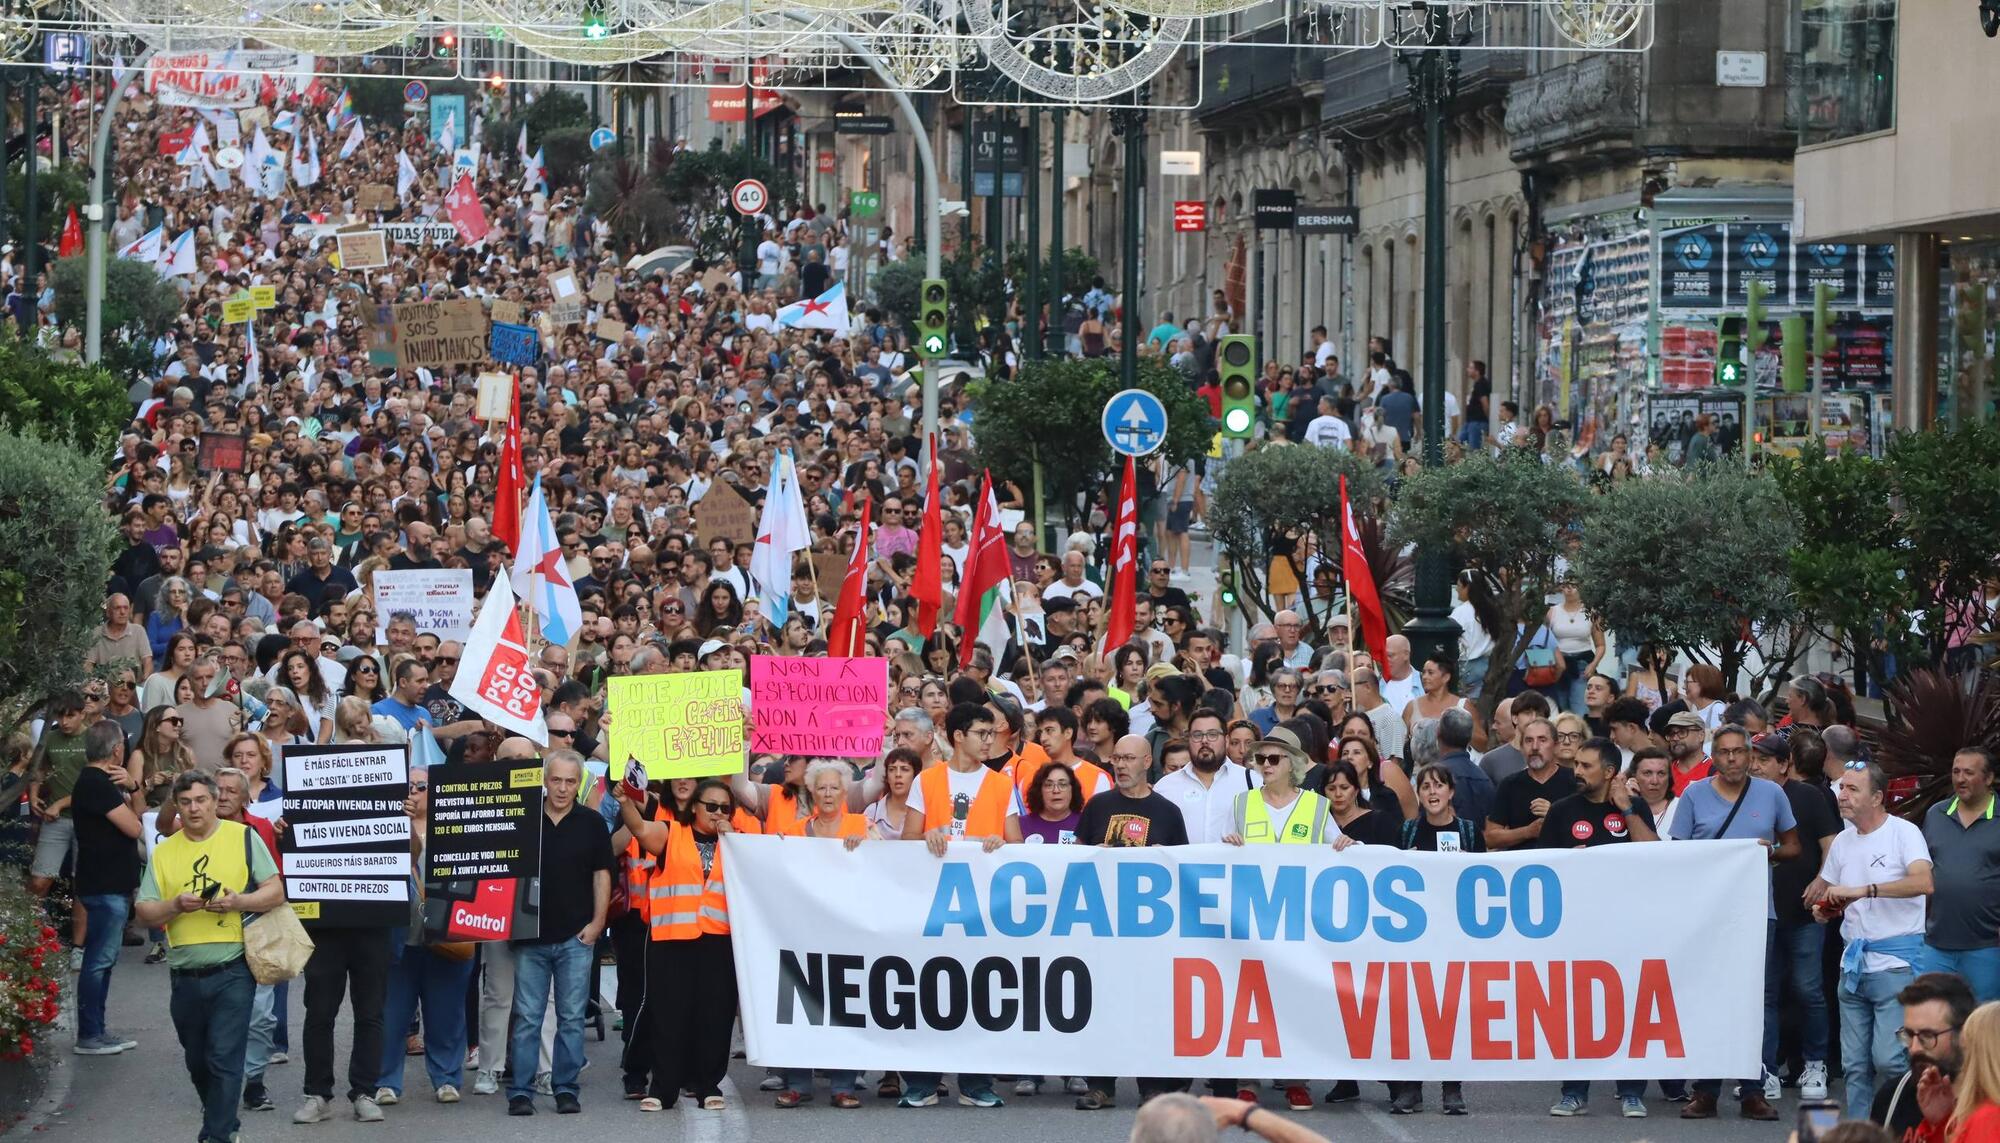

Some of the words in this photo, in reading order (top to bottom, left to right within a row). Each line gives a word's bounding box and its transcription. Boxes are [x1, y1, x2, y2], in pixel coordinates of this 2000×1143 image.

[740, 190, 760, 203] 40
[1298, 216, 1354, 225] BERSHKA
[406, 321, 439, 337] SOIS
[770, 661, 820, 677] NON
[485, 663, 517, 704] PSG
[754, 681, 878, 702] ESPECULACION
[758, 708, 797, 727] NON
[808, 705, 819, 728] Á
[754, 733, 883, 753] XENTRIFICACION
[304, 759, 310, 771] É
[312, 756, 331, 770] MÁIS
[332, 756, 354, 768] FÁCIL
[355, 756, 387, 767] ENTRAR
[303, 778, 313, 788] NA
[352, 774, 363, 784] DE
[364, 772, 393, 783] BENITO
[436, 785, 441, 793] O
[442, 784, 469, 793] CONTROL
[470, 783, 479, 791] DE
[480, 782, 503, 790] PREZOS
[283, 799, 300, 810] QUE
[302, 799, 335, 810] ATOPAR
[336, 800, 373, 811] VIVENDA
[374, 800, 387, 811] EN
[388, 801, 404, 811] VIG
[436, 798, 465, 807] PREVISTO
[466, 797, 474, 806] NA
[476, 796, 485, 805] LEI
[486, 796, 495, 804] DE
[496, 794, 522, 804] VIVENDA
[435, 810, 461, 821] SUPORÍA
[462, 811, 471, 819] UN
[472, 810, 495, 819] AFORRO
[496, 809, 504, 817] DE
[506, 808, 526, 816] ENTRE
[303, 825, 327, 840] MÁIS
[329, 825, 371, 839] VIVENDA
[373, 822, 408, 835] SOCIAL
[435, 826, 445, 835] 120
[446, 826, 450, 834] E
[464, 824, 484, 833] EUROS
[485, 822, 517, 832] MENSUAIS.
[296, 858, 343, 869] ALUGUEIROS
[344, 856, 363, 867] MÁIS
[364, 856, 398, 866] BARATOS
[434, 854, 438, 863] O
[439, 853, 470, 862] CONCELLO
[471, 852, 479, 860] DE
[481, 851, 495, 859] VIGO
[496, 850, 507, 859] NIN
[508, 850, 520, 858] LLE
[433, 868, 451, 876] PEDIU
[458, 866, 478, 875] XUNTA
[300, 882, 339, 893] CONTROL
[341, 883, 352, 893] DE
[354, 884, 389, 894] PREZOS
[923, 861, 1428, 943] ACABEMOS
[1456, 864, 1563, 939] CO
[456, 909, 506, 933] Control
[776, 950, 1093, 1033] NEGOCIO
[1173, 958, 1282, 1058] DA
[1331, 959, 1685, 1061] VIVENDA
